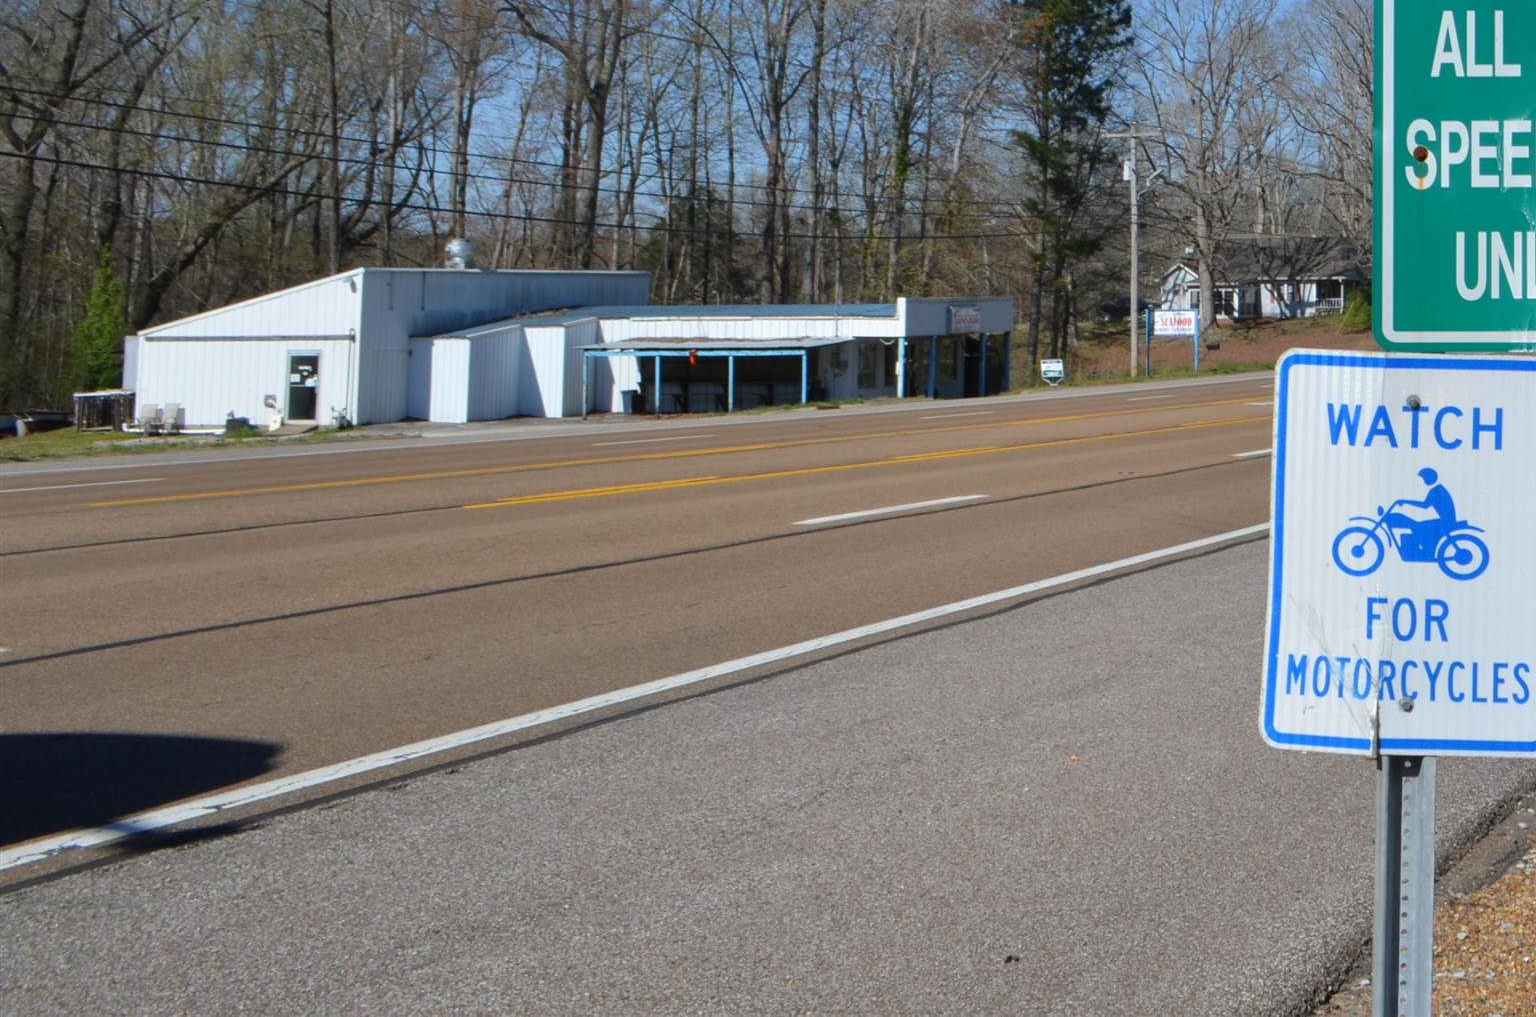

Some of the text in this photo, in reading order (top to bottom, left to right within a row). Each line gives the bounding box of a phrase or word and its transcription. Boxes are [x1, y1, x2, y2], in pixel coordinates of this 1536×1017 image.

[1430, 9, 1522, 78] ALL
[1327, 403, 1504, 451] WATCH
[1366, 597, 1449, 643] FOR
[1286, 653, 1531, 705] MOTORCYCLES
